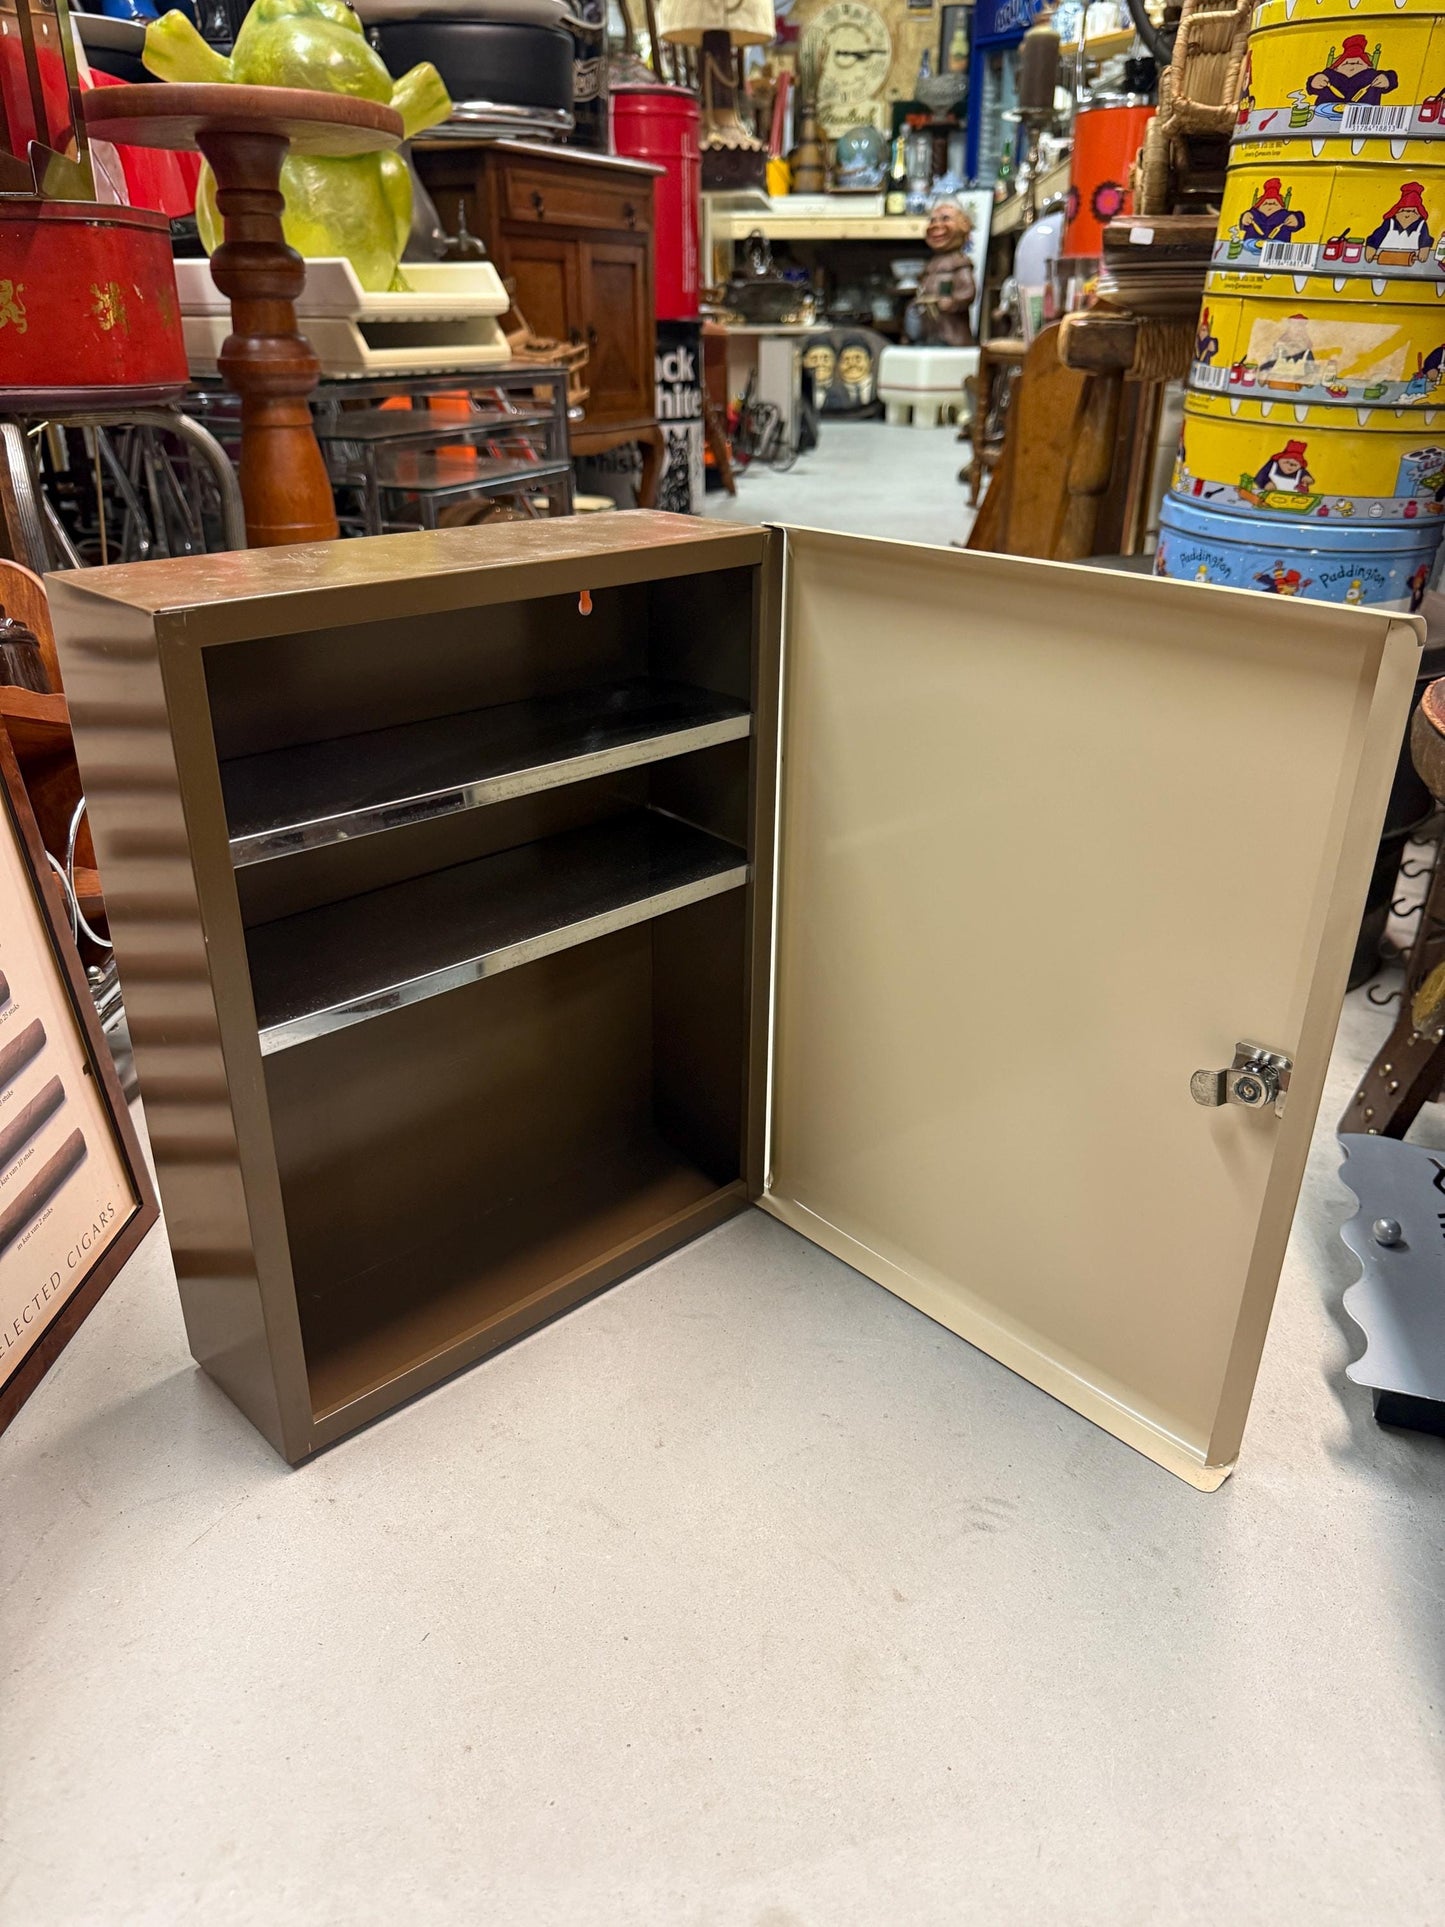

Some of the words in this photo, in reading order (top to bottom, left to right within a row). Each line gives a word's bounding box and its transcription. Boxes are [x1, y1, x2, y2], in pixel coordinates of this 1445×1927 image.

[1179, 548, 1231, 578] Paddington
[1319, 565, 1385, 588] Paddington
[23, 1148, 35, 1162] stuks
[22, 1233, 31, 1244] kist
[30, 1223, 40, 1234] van
[42, 1207, 54, 1221] stuks
[66, 1202, 116, 1269] CIGARS
